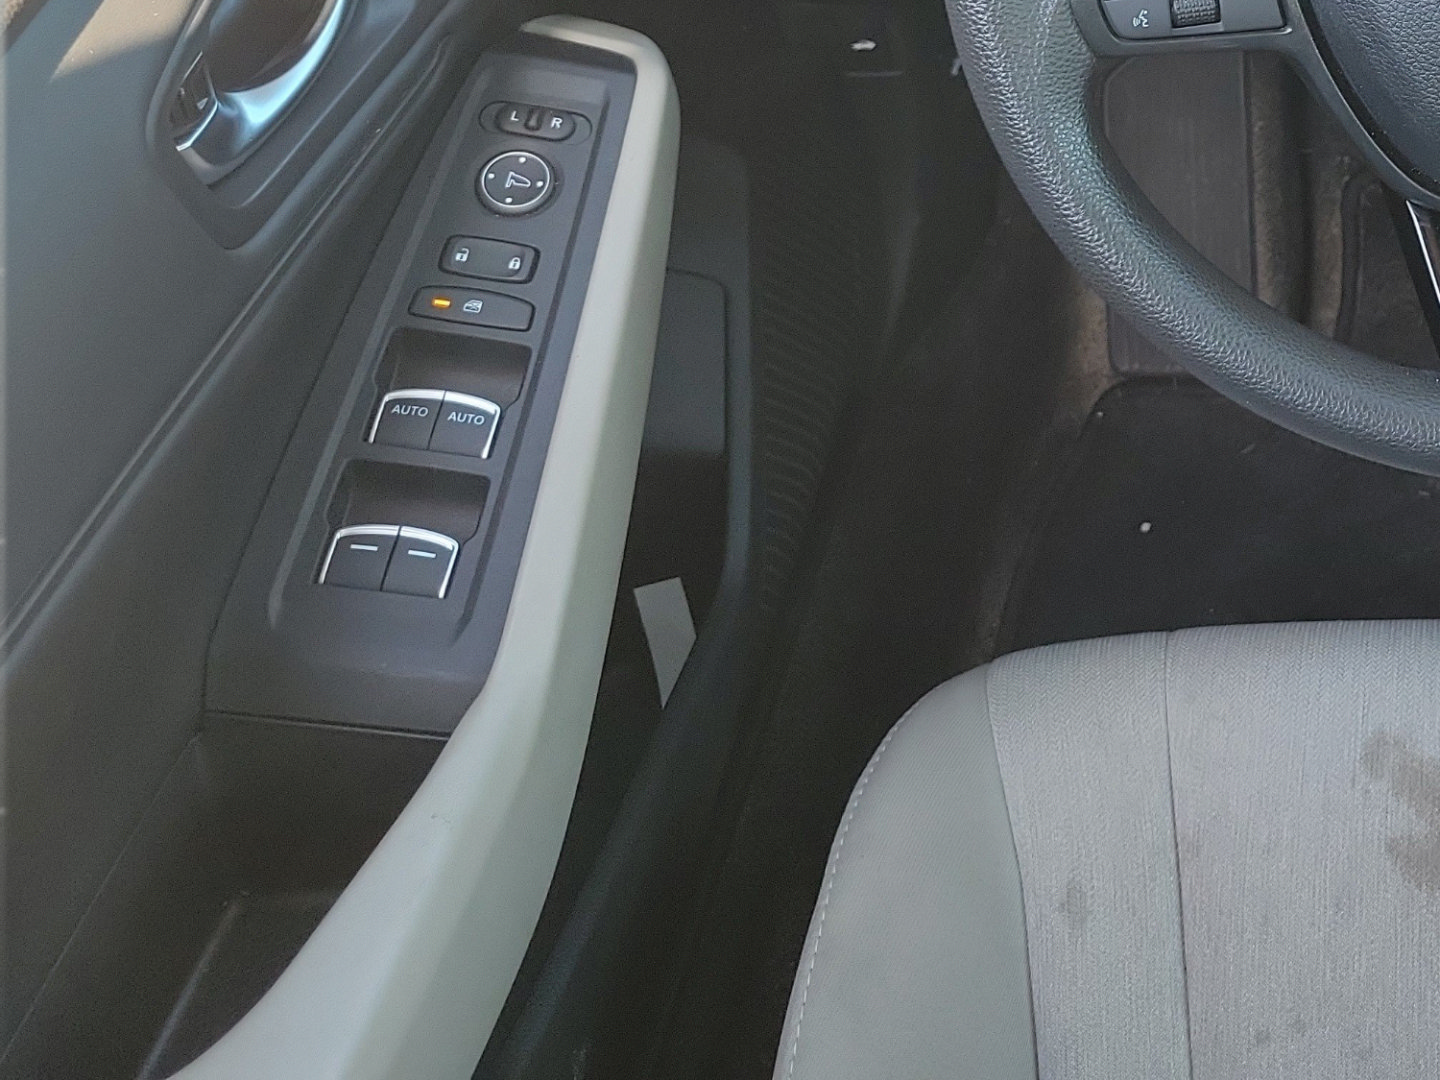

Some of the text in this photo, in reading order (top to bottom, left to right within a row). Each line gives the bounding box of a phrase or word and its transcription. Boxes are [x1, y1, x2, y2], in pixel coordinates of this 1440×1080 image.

[510, 111, 520, 121] L
[550, 116, 563, 129] R
[391, 404, 429, 419] AUTO
[446, 410, 485, 426] AUTO
